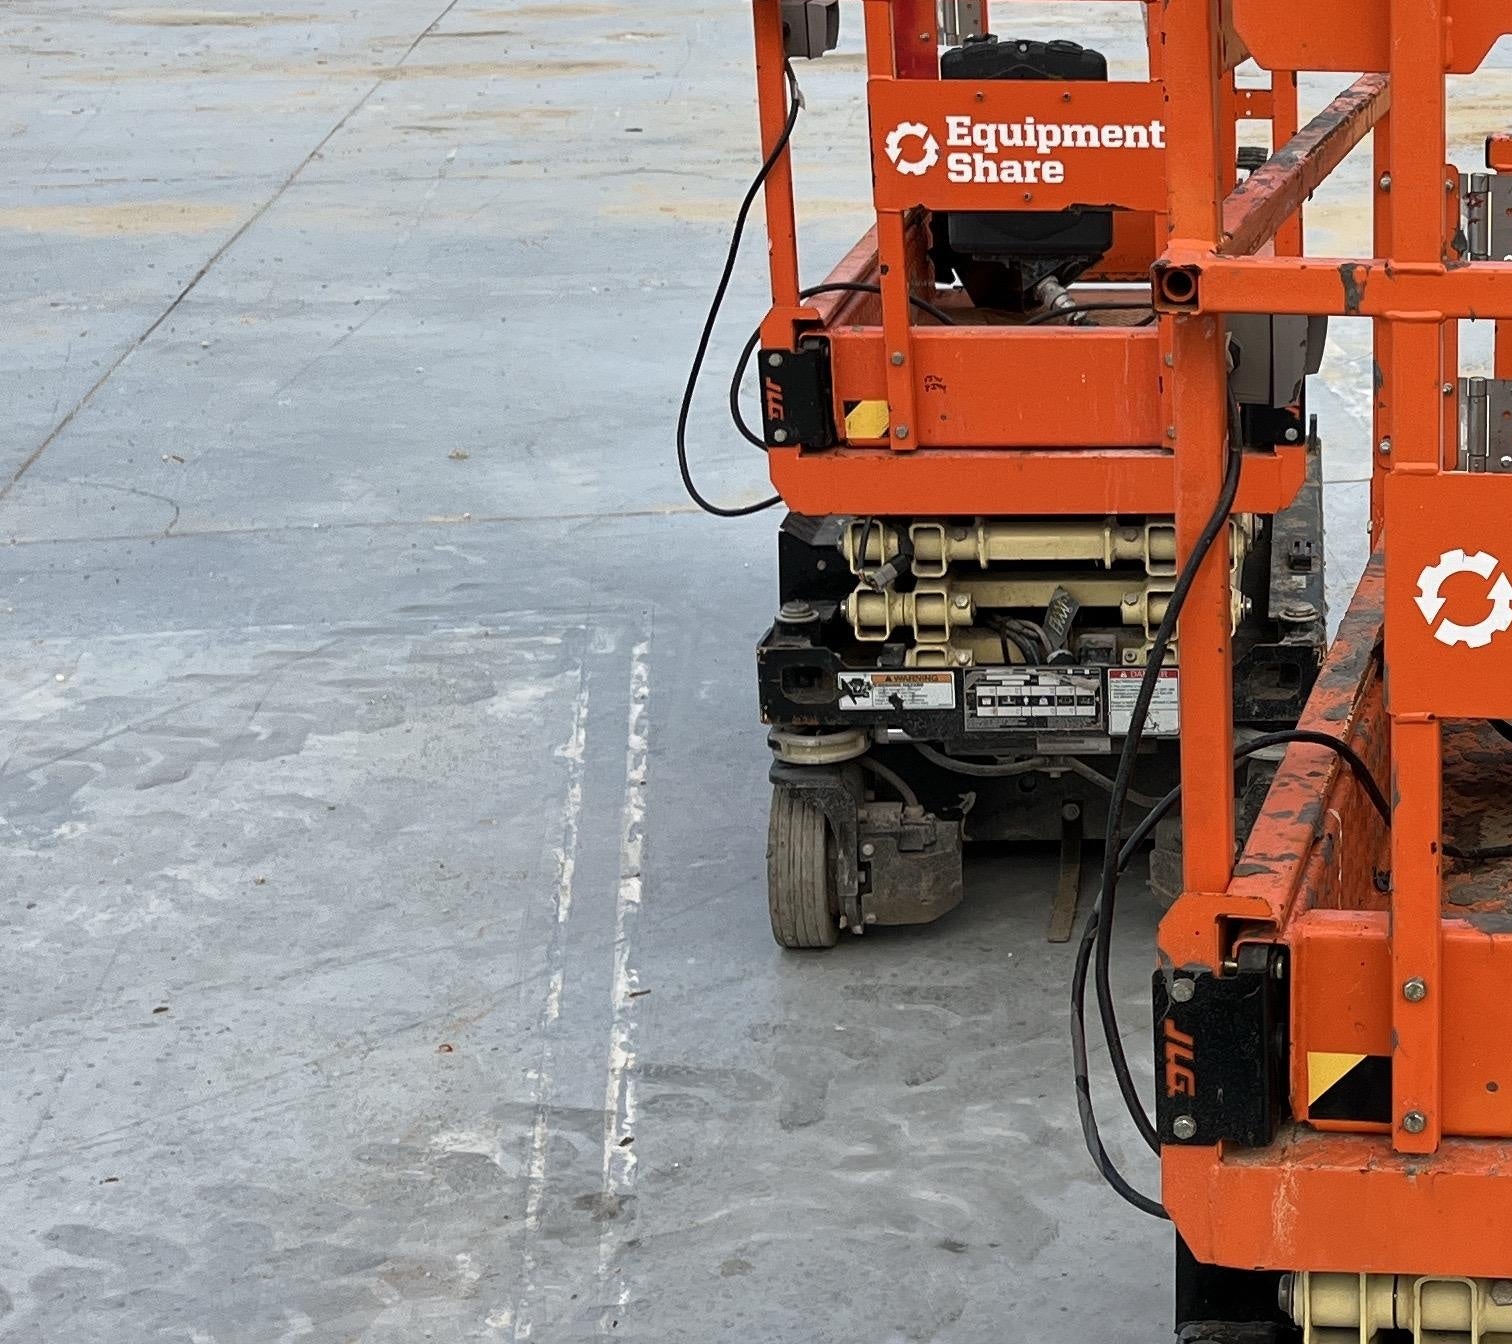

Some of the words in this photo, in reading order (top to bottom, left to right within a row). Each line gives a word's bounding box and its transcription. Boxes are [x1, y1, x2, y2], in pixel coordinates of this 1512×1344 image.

[945, 115, 1166, 154] Equipment
[946, 152, 1065, 184] Share
[765, 376, 785, 422] JLG
[1163, 1017, 1197, 1098] JLG
